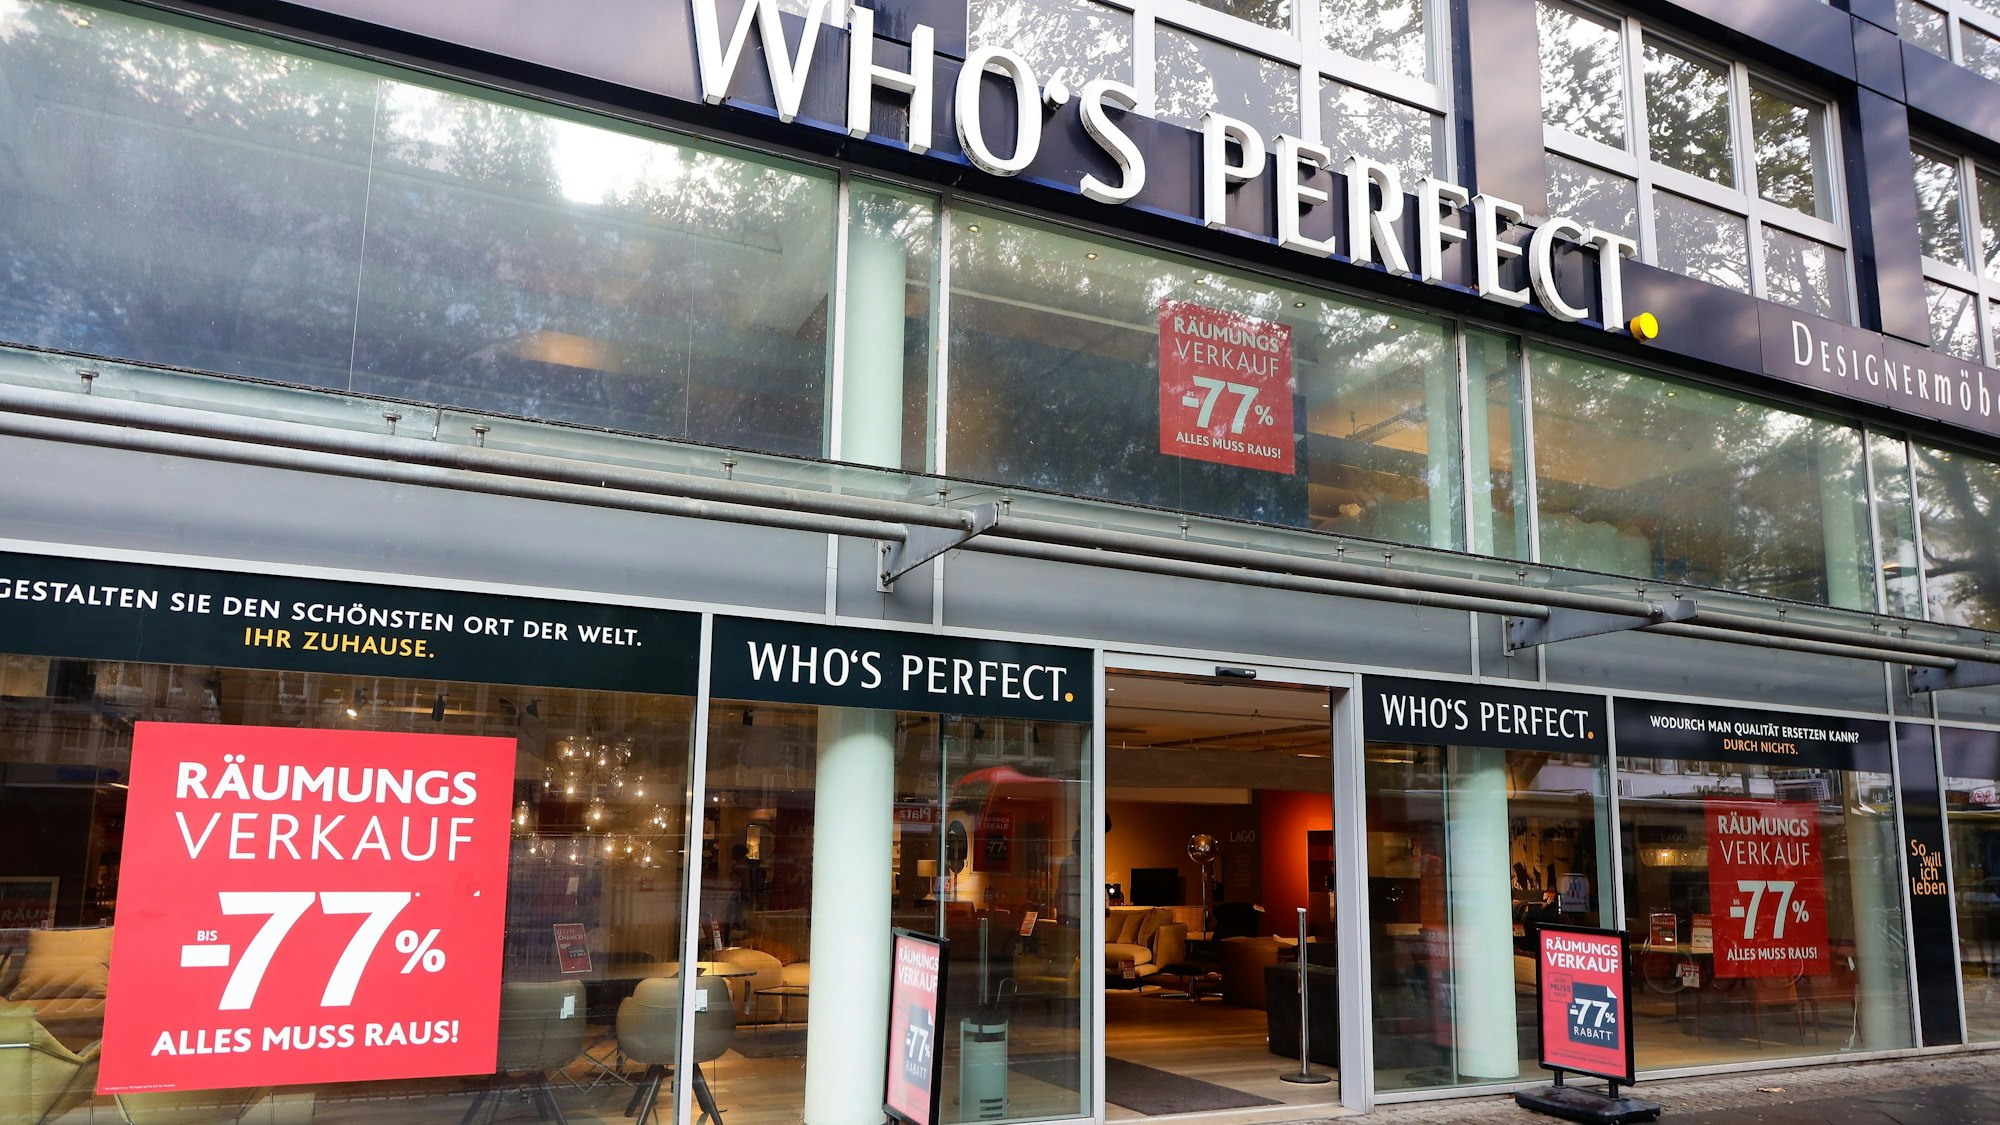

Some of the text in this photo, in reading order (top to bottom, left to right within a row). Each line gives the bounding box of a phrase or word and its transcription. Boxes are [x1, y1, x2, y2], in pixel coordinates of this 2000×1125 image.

[1200, 112, 1659, 341] PERFECT.
[1174, 315, 1280, 353] RÄUMUNGS
[1175, 337, 1280, 377] VERKAUF
[1792, 320, 2000, 417] DESIGNERmöb
[1176, 431, 1281, 459] ALLES MUSS RAUS!
[0, 578, 643, 647] GESTALTEN SIE DEN SCHÖNSTEN ORT DER WELT.
[243, 627, 435, 659] IHR ZUHAUSE.
[746, 640, 1075, 704] WHO'S PERFECT.
[1380, 693, 1595, 741] WHO'S PERFECT.
[1650, 715, 1859, 744] WODURCH MAN QUALITÄT ERSETZEN KANN?
[1724, 738, 1798, 755] DURCH NICHTS.
[176, 753, 477, 806] RÄUMUNGS
[175, 811, 475, 861] VERKAUF
[1230, 830, 1255, 842] LAGO
[1718, 811, 1809, 837] RÄUMUNGS
[1720, 840, 1810, 866] VERKAUF
[1911, 839, 1926, 856] So
[1922, 852, 1942, 867] will
[1920, 863, 1938, 880] ich
[1912, 877, 1946, 895] leben
[197, 930, 218, 942] BIS
[1546, 937, 1619, 957] RÄUMUNGS
[898, 946, 939, 971] RÄUMUNGS
[1546, 952, 1619, 973] VERKAUF
[1727, 946, 1817, 961] ALLES MUSS RAUS!
[898, 965, 938, 993] VERKAUF
[1550, 983, 1571, 992] MUSS
[150, 1020, 460, 1056] ALLES MUSS RAUS!
[1573, 1026, 1613, 1041] RABATT
[906, 1060, 928, 1080] RABATT
